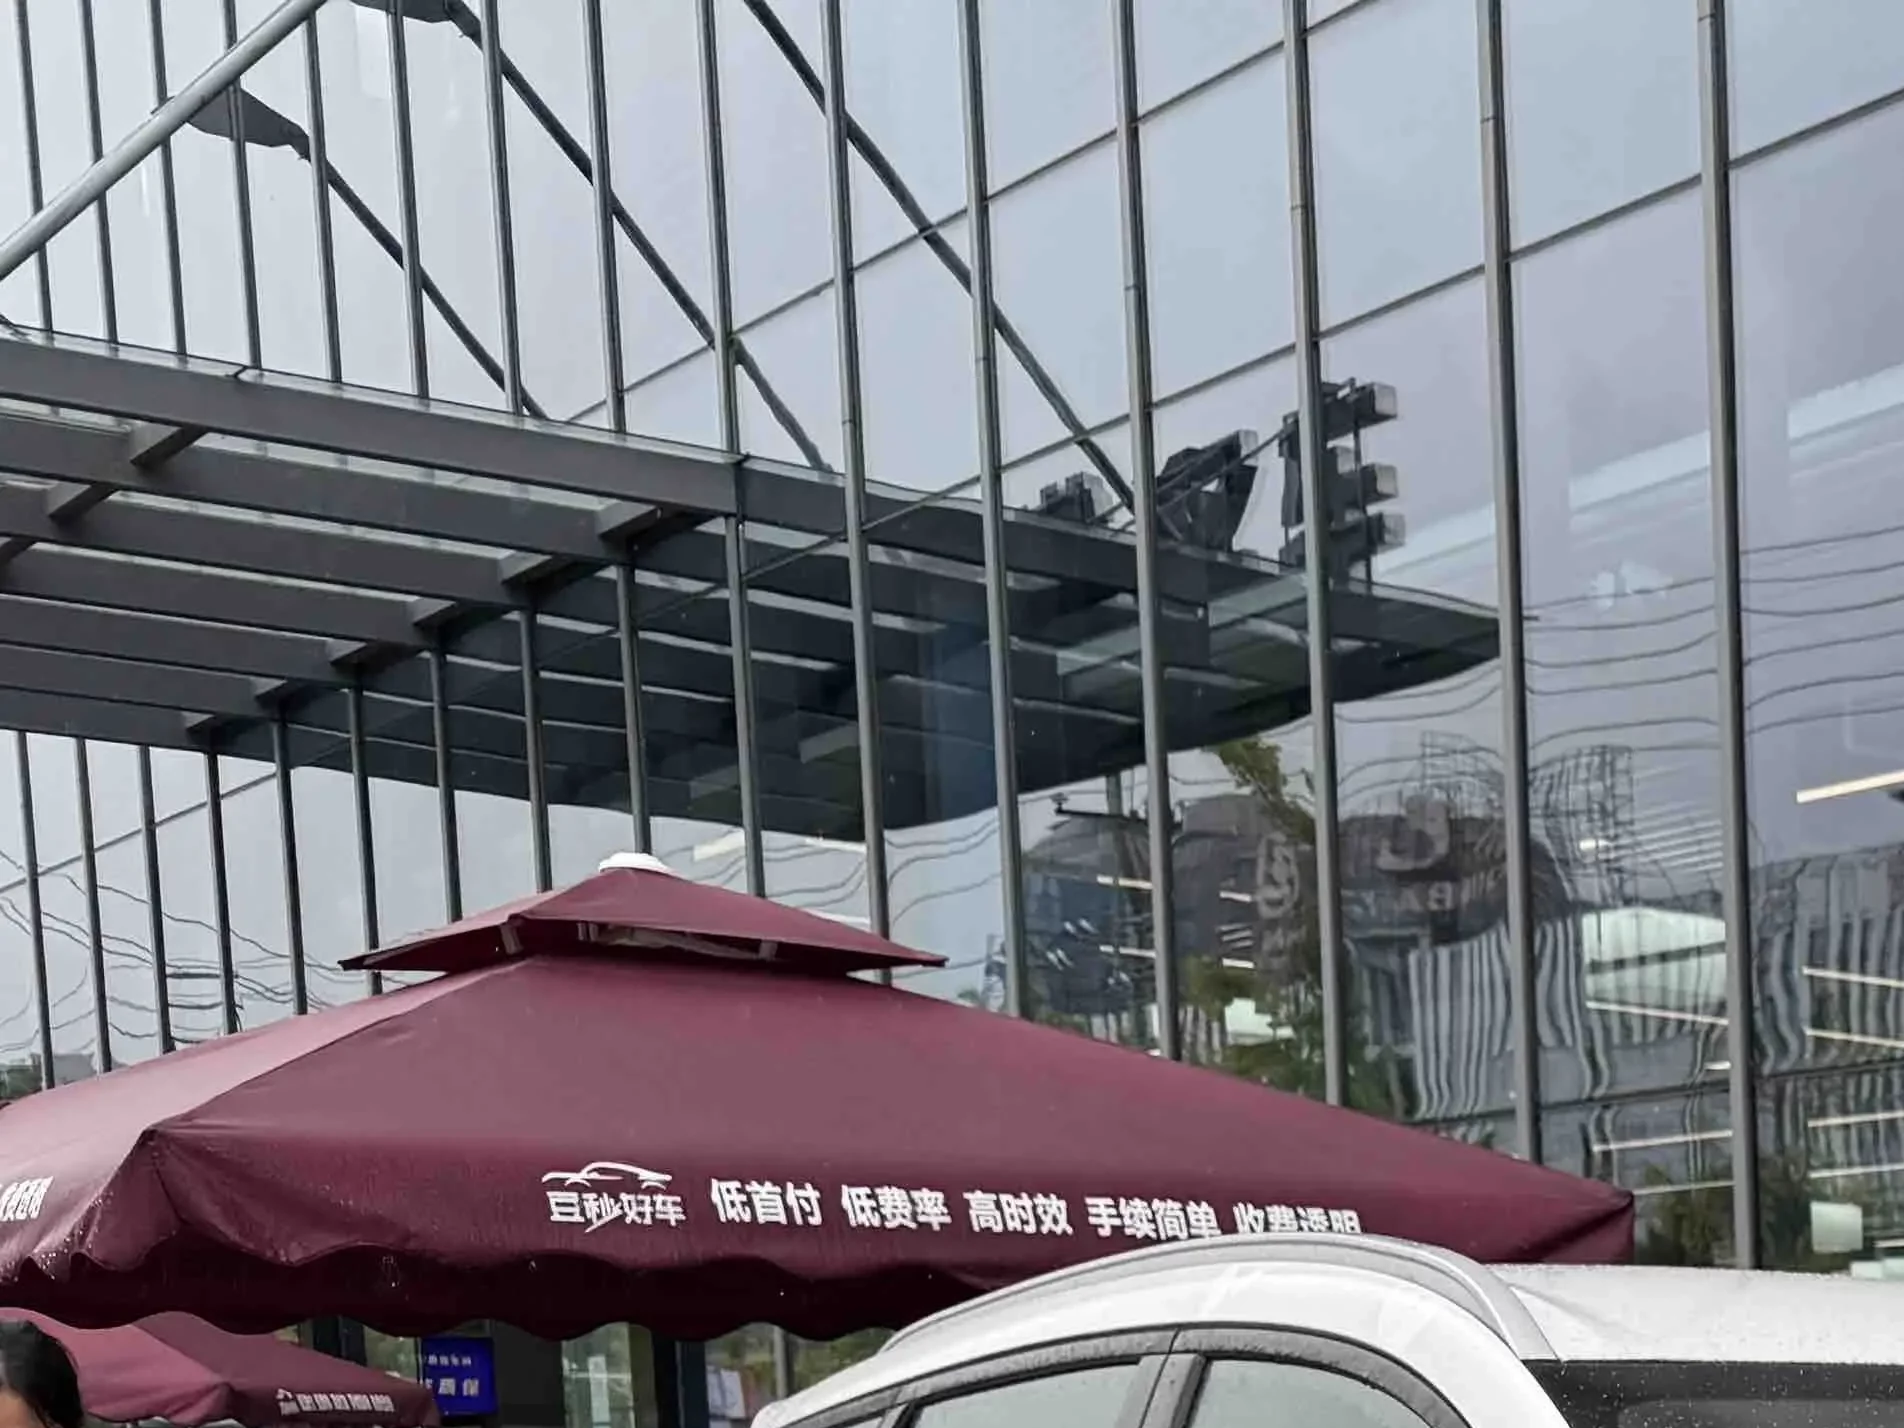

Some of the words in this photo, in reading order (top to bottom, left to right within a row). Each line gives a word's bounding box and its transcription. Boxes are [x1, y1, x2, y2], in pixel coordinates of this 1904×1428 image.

[711, 1178, 823, 1226] 低首付
[841, 1184, 951, 1231] 低费率
[963, 1190, 1073, 1235] 高时效
[1085, 1197, 1222, 1239] 手续简单
